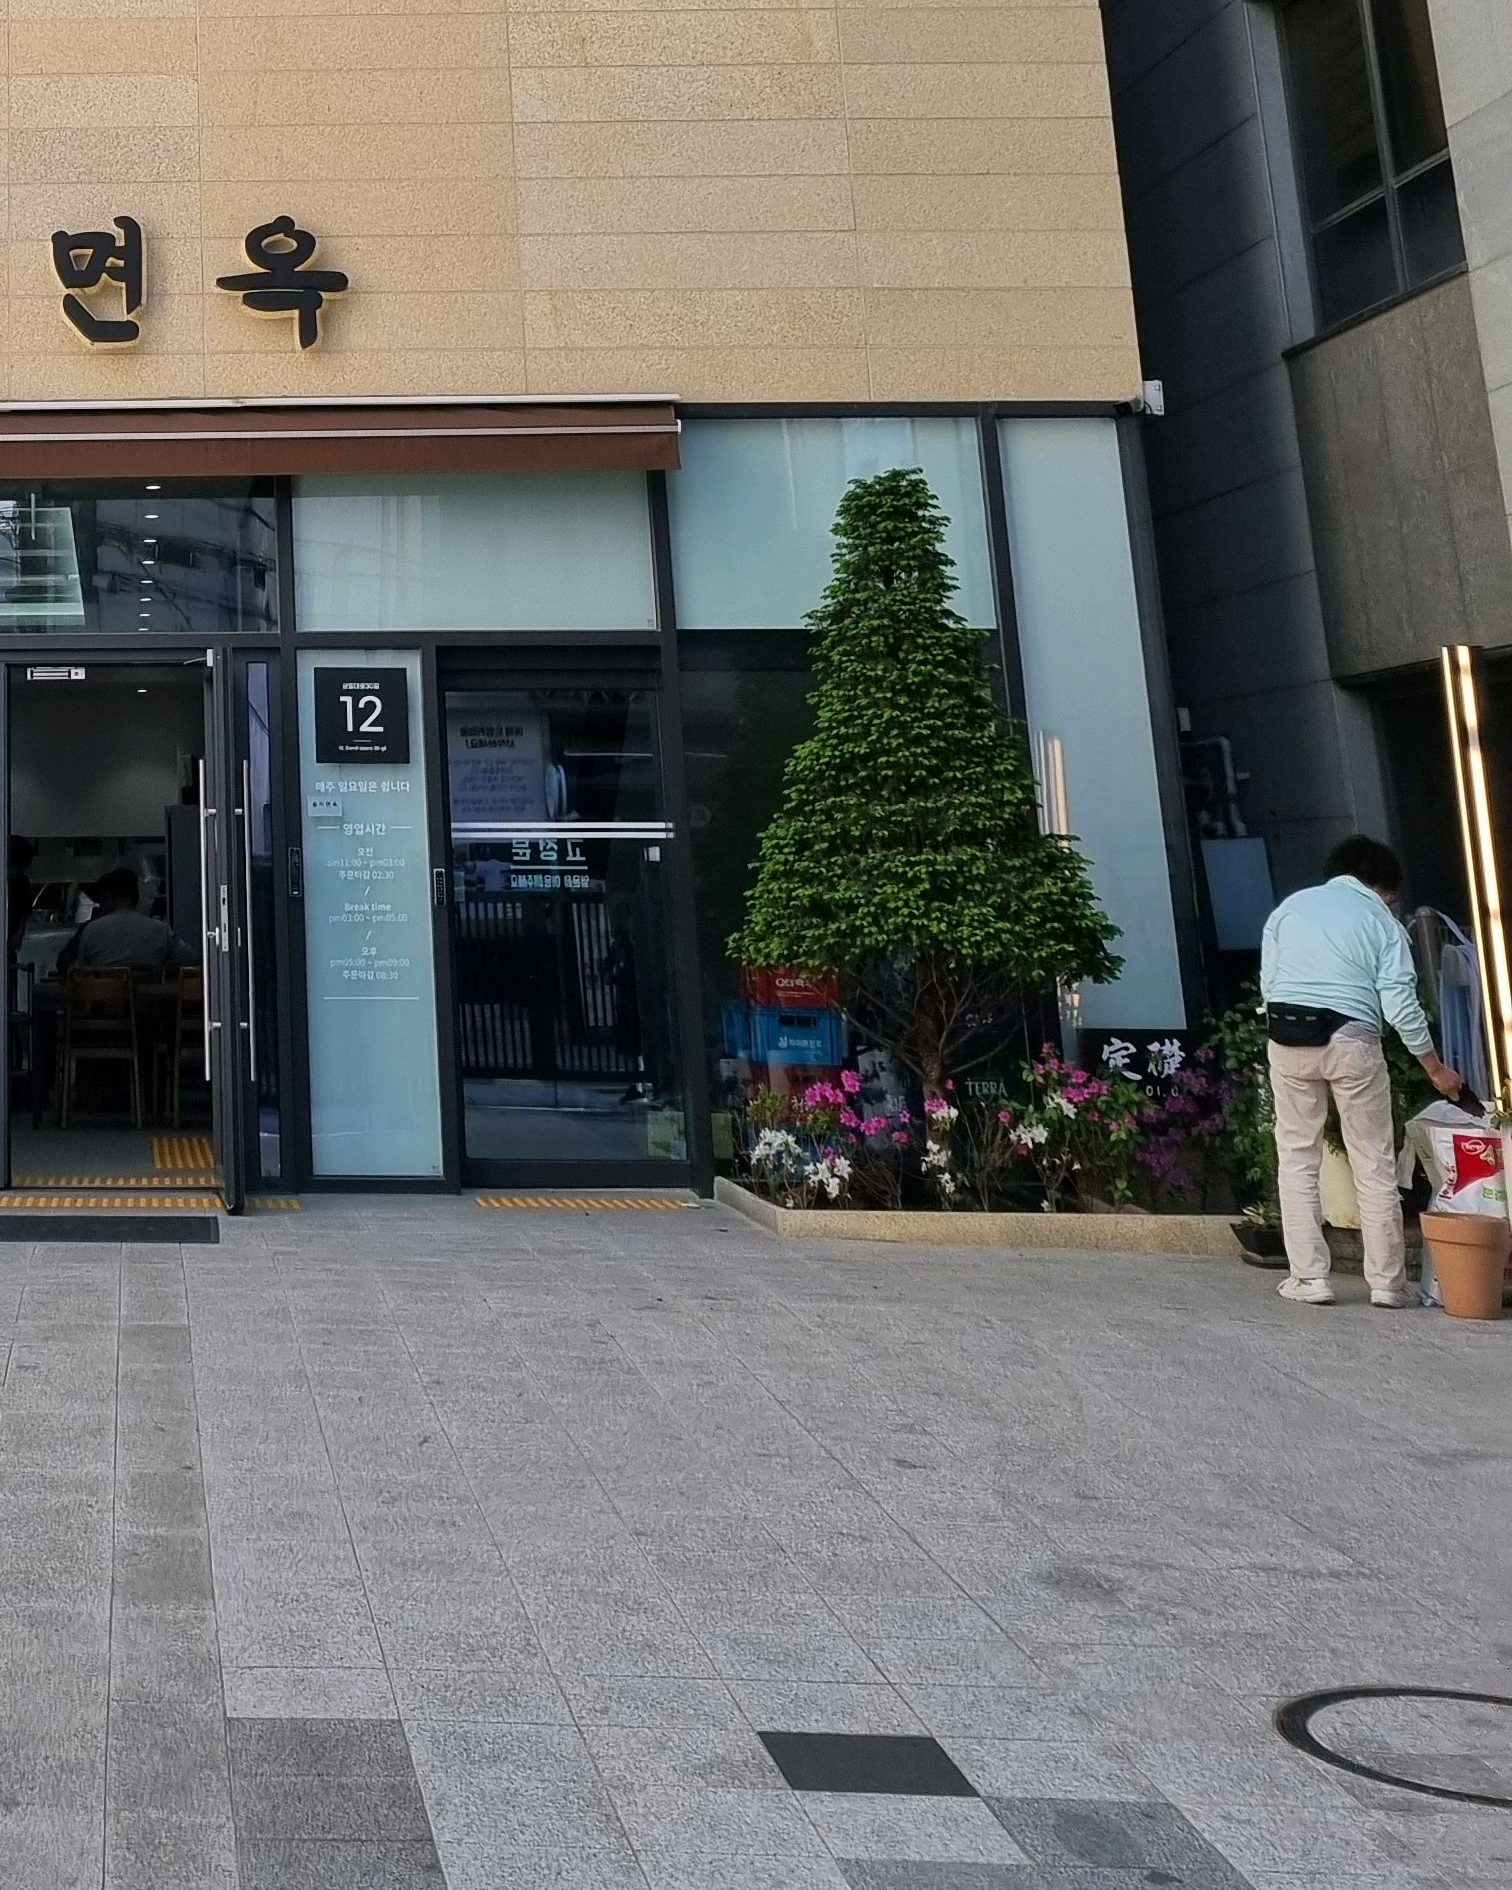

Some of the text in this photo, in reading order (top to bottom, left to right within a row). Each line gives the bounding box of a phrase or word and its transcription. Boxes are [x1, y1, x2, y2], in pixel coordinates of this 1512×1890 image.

[339, 695, 384, 732] 12
[338, 780, 377, 793] 일요일은
[342, 822, 386, 836] 영업시간
[344, 902, 392, 911] Break time
[965, 1077, 1009, 1098] TERRA
